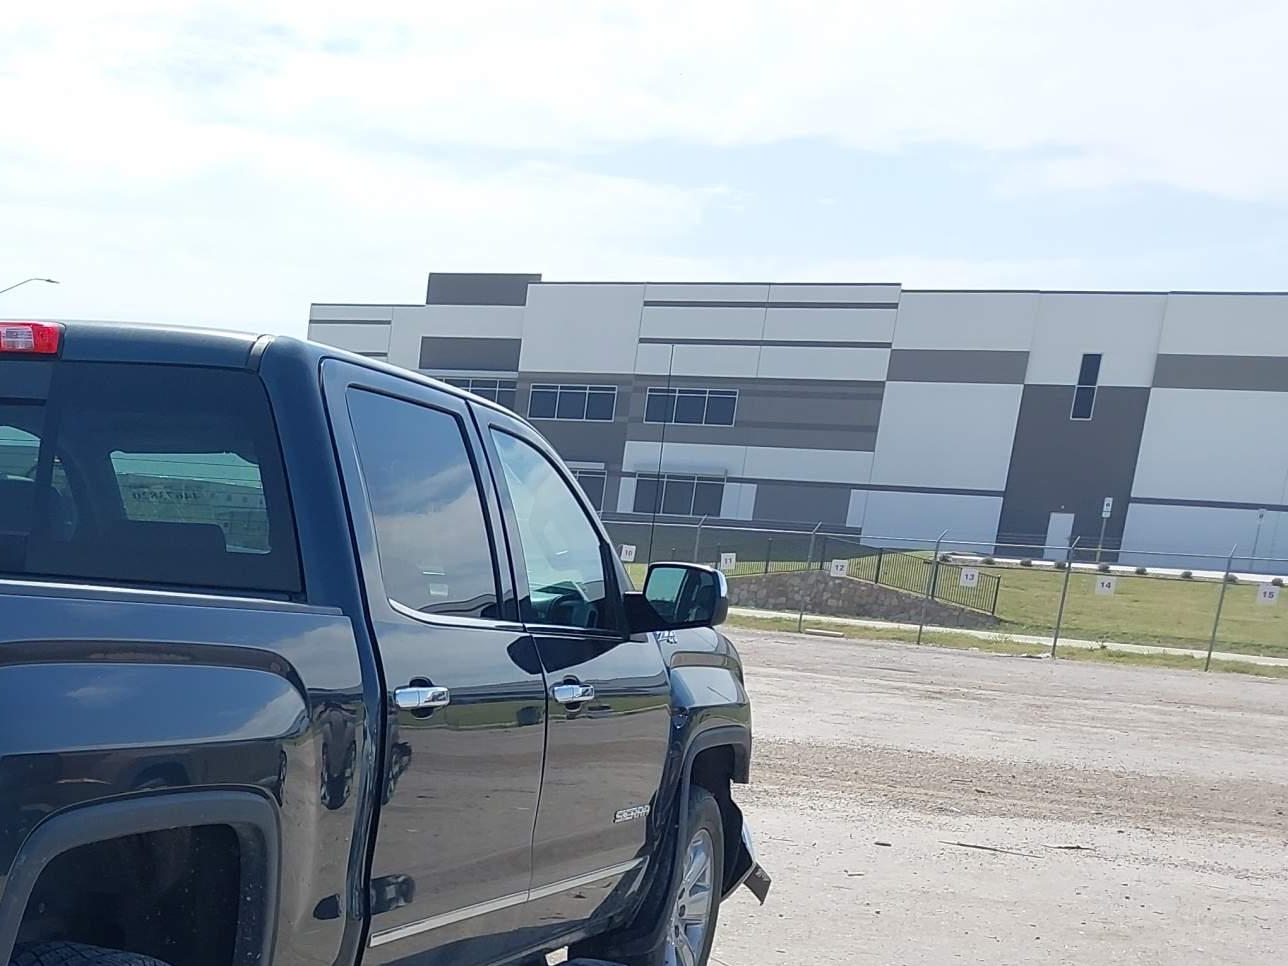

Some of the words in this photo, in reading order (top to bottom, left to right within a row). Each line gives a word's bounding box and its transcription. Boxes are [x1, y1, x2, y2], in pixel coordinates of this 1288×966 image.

[964, 573, 976, 581] 13
[1263, 591, 1275, 599] 15
[614, 804, 650, 823] SIERRA
